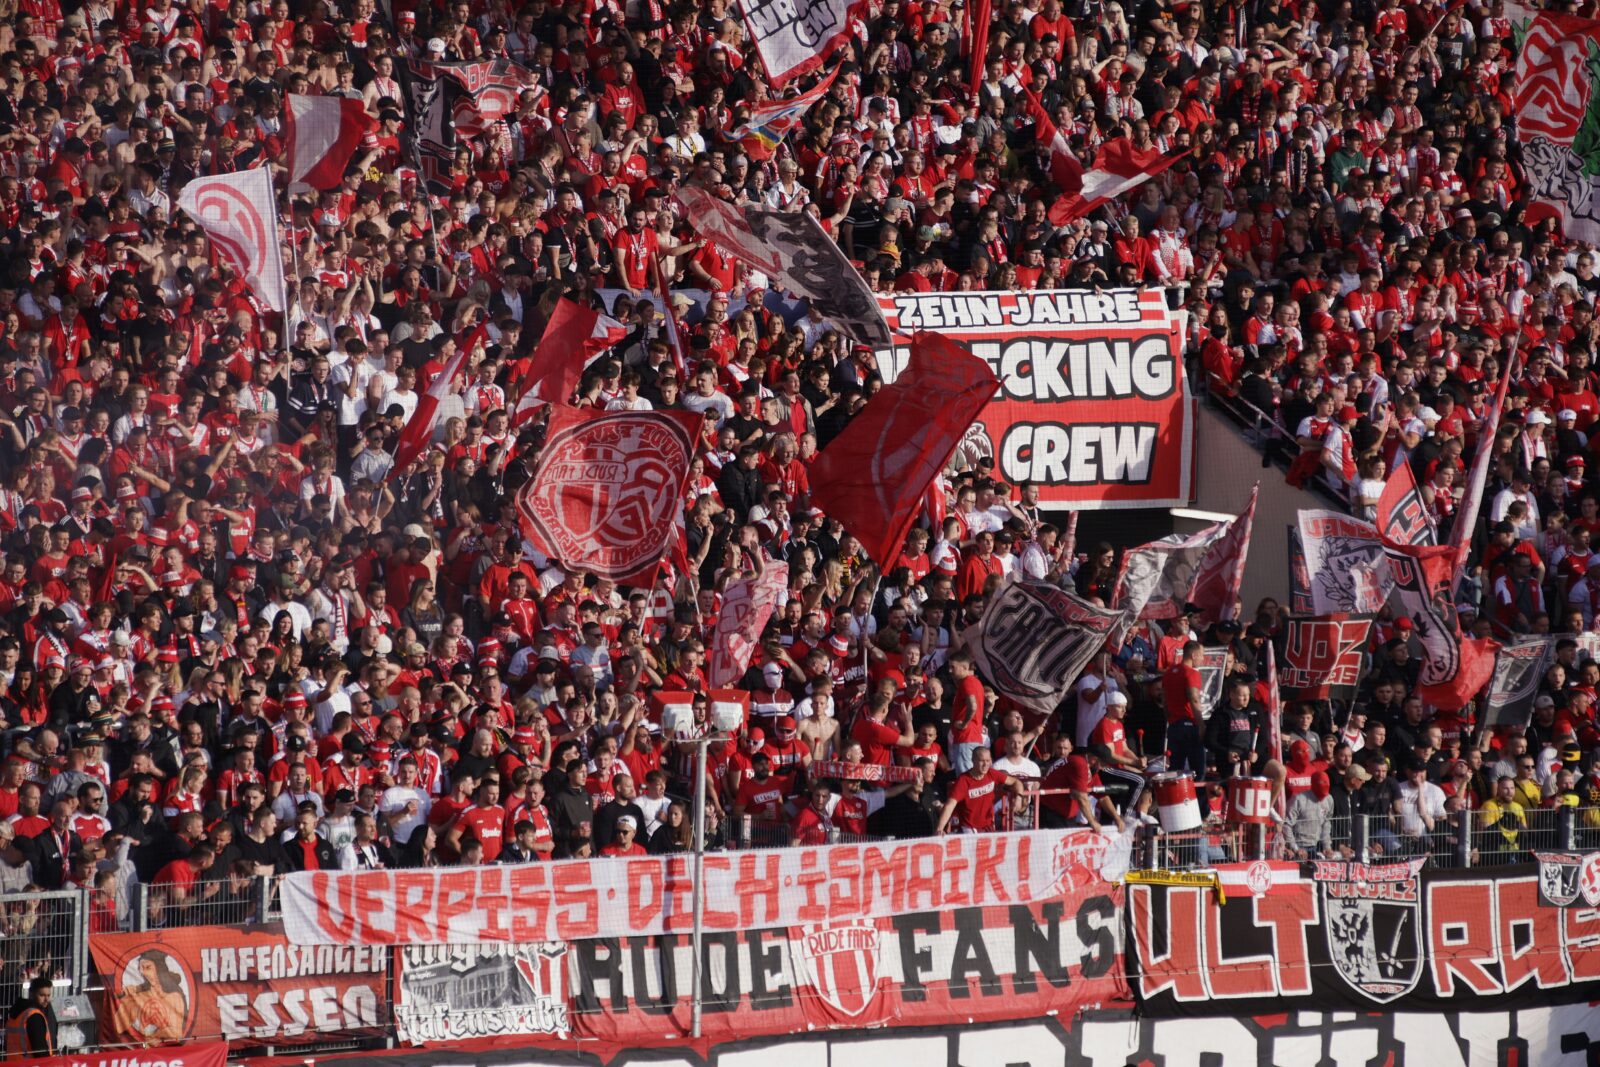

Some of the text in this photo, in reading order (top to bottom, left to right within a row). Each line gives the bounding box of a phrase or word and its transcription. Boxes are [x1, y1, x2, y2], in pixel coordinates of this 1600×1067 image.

[895, 292, 1142, 328] ZEHN JAHRE
[1001, 421, 1160, 485] CREW
[576, 895, 1117, 1015] RUDE FANS
[807, 928, 876, 957] RUDE FANS
[217, 985, 377, 1041] ESSEN
